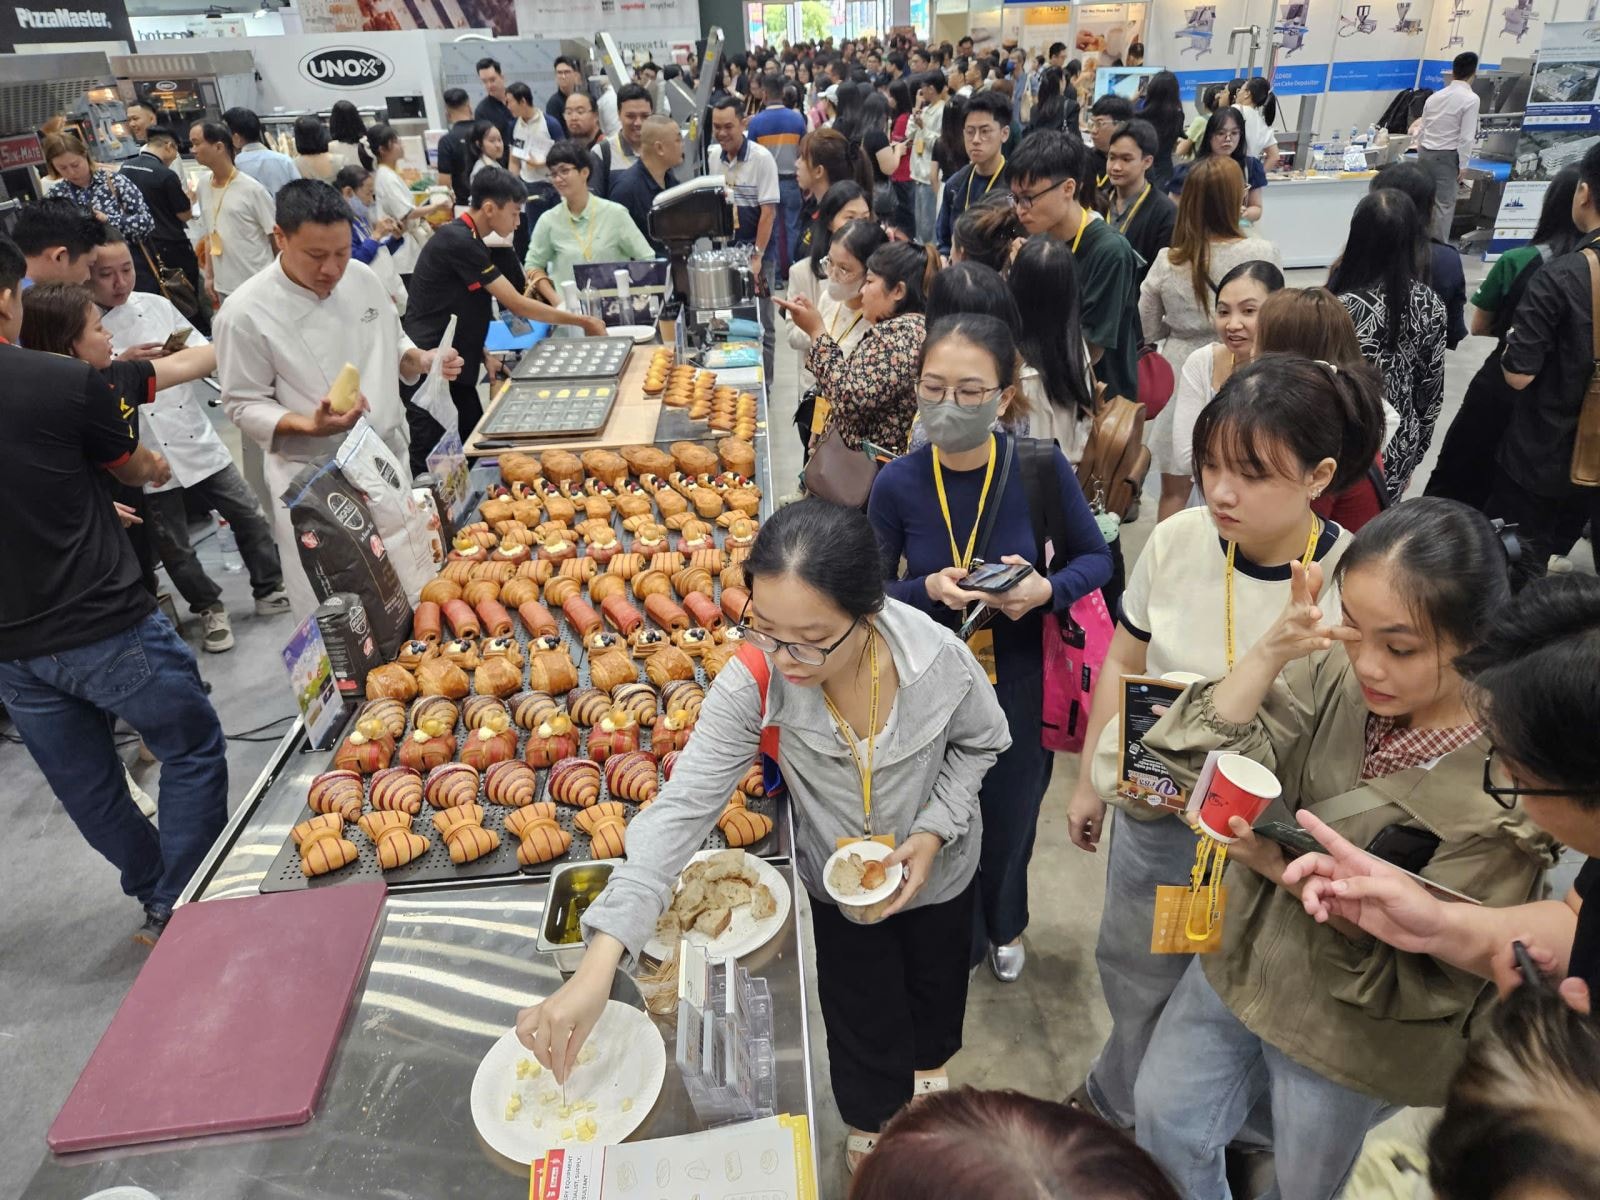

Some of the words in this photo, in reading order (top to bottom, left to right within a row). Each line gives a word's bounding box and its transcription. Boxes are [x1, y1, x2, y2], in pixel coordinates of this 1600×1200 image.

[309, 58, 378, 78] UNOX
[1295, 79, 1320, 88] Depositor
[565, 1155, 573, 1189] EQUIPMENT
